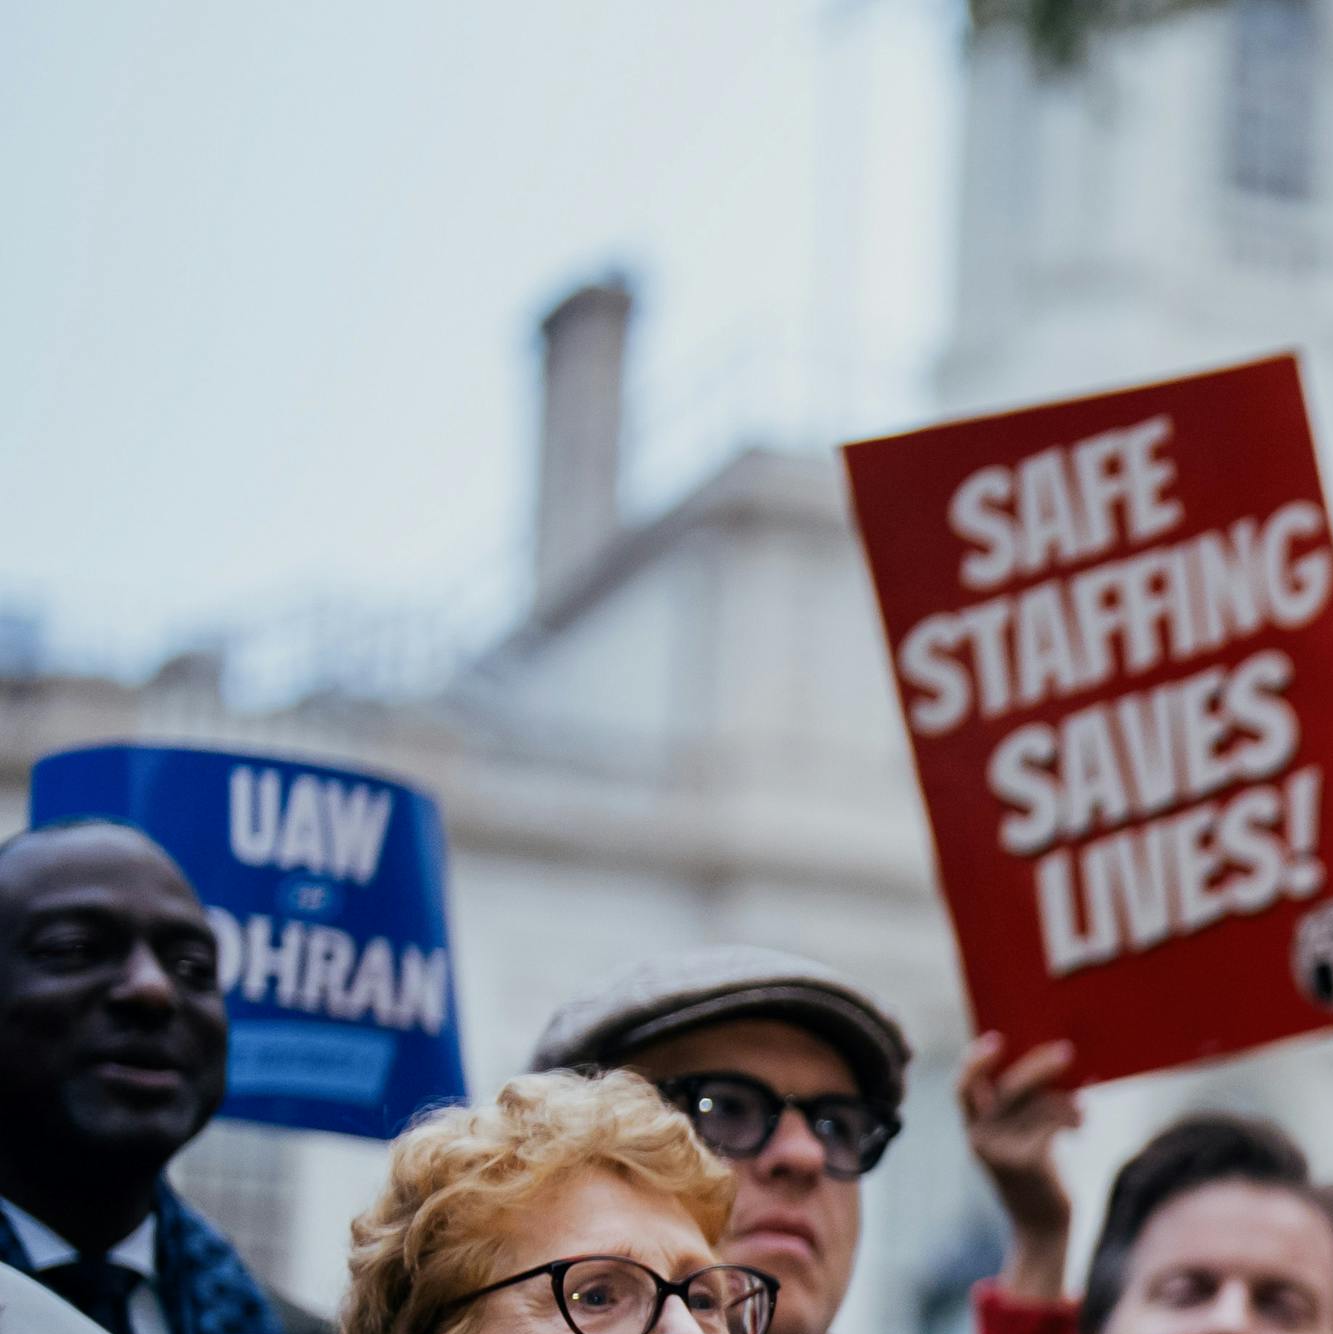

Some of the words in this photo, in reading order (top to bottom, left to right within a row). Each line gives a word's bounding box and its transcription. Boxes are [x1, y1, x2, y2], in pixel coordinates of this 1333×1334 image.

[948, 414, 1184, 590] SAFE
[899, 499, 1333, 738] STAFFING
[228, 764, 392, 885] UAW
[986, 649, 1298, 857] SAVES
[1031, 767, 1326, 979] LIVES!
